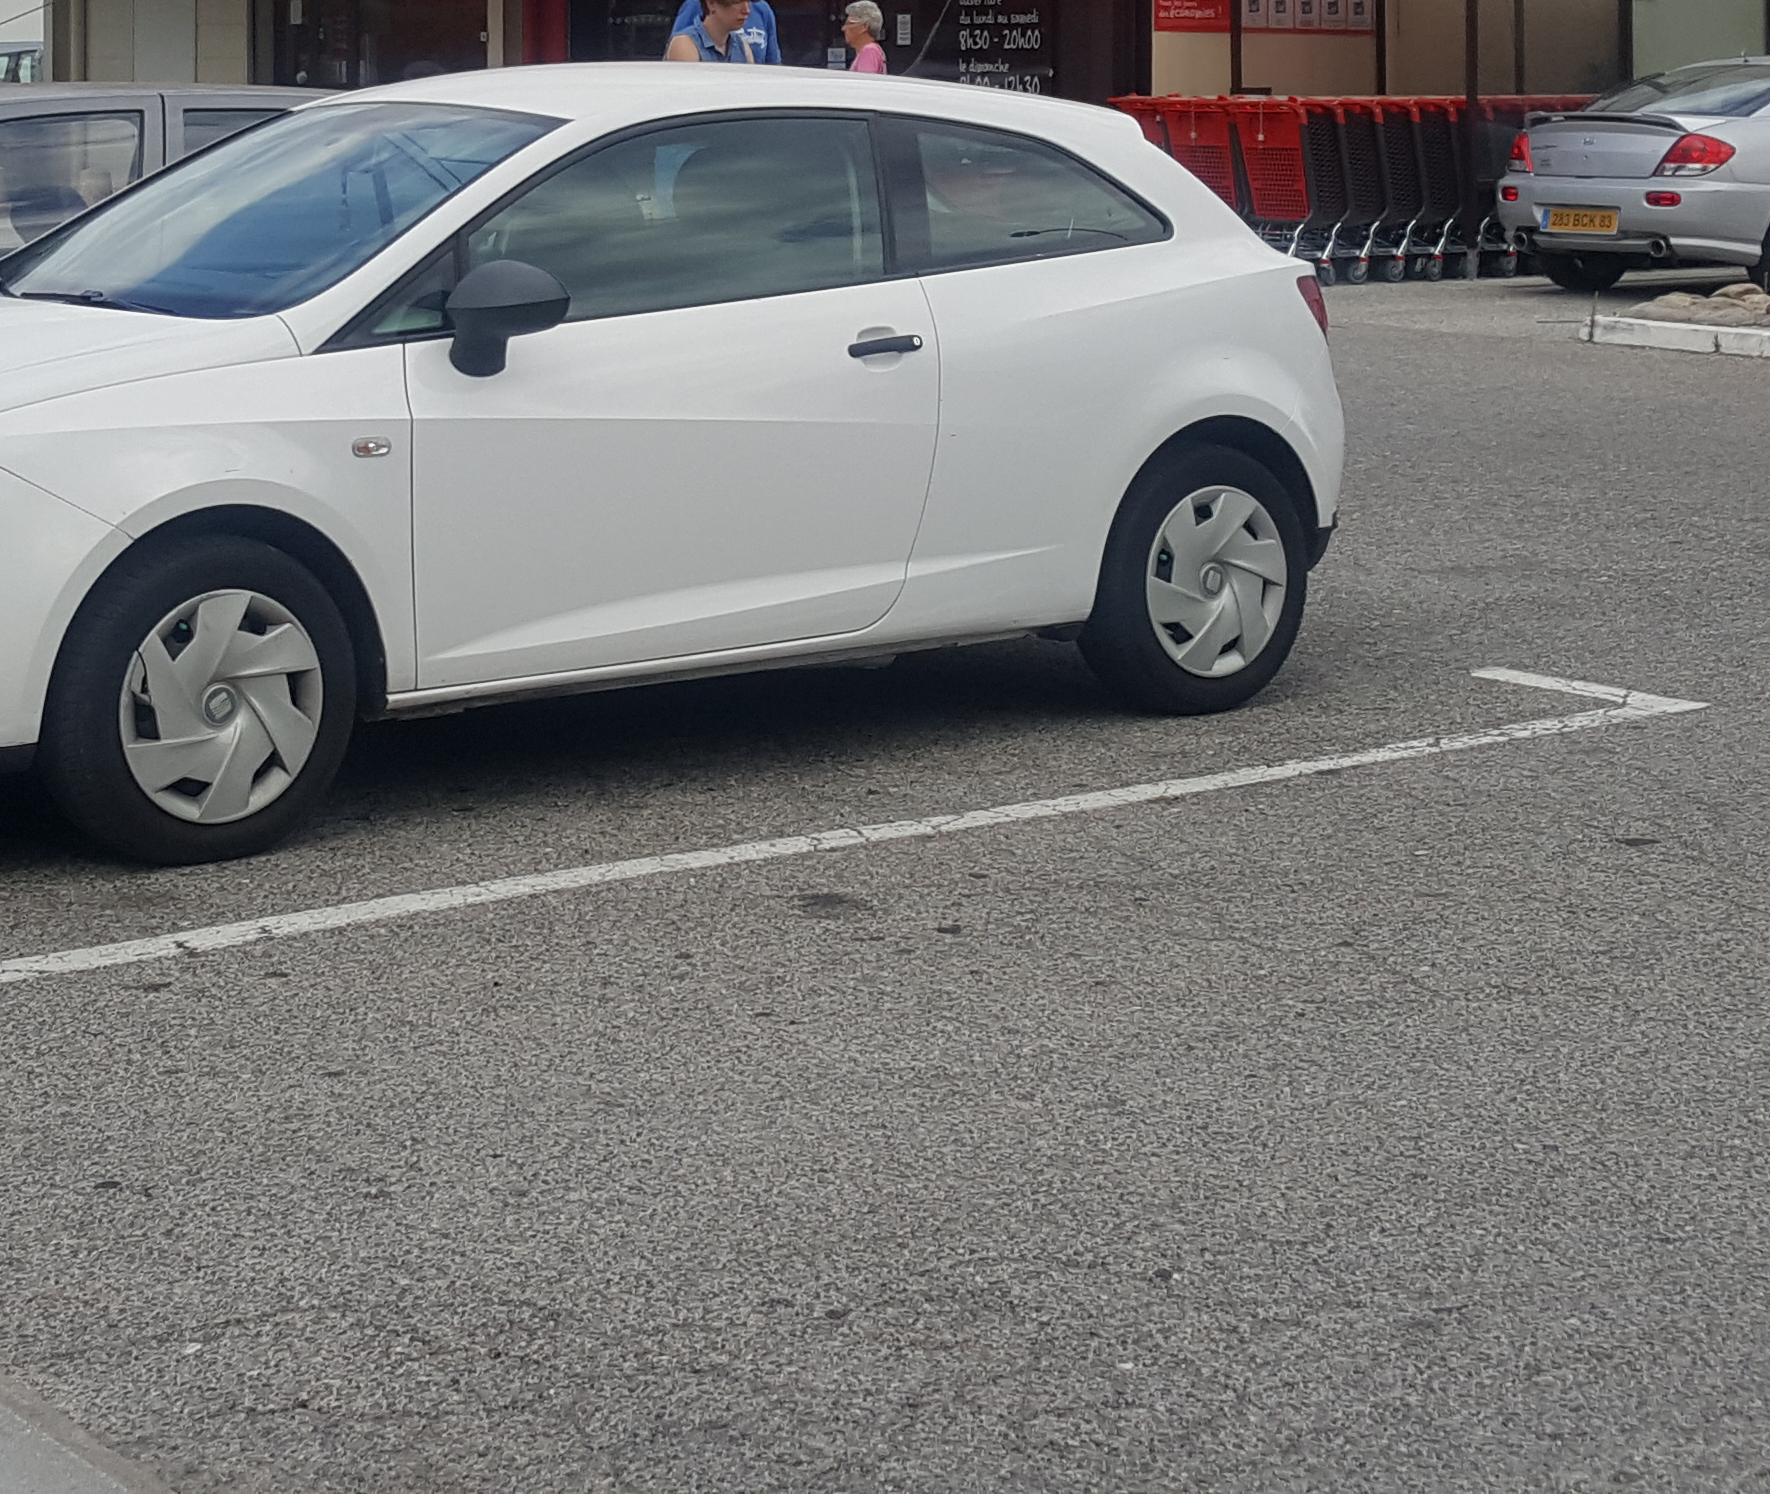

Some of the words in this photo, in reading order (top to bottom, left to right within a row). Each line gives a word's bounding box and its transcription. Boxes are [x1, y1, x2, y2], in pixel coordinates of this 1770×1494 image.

[959, 9, 972, 24] du
[973, 8, 995, 24] lundi
[997, 14, 1008, 24] au
[1010, 8, 1039, 24] samedi
[959, 28, 990, 50] 8h30
[1002, 29, 1041, 50] 20h00
[959, 58, 967, 72] le
[969, 57, 1010, 73] dimanche
